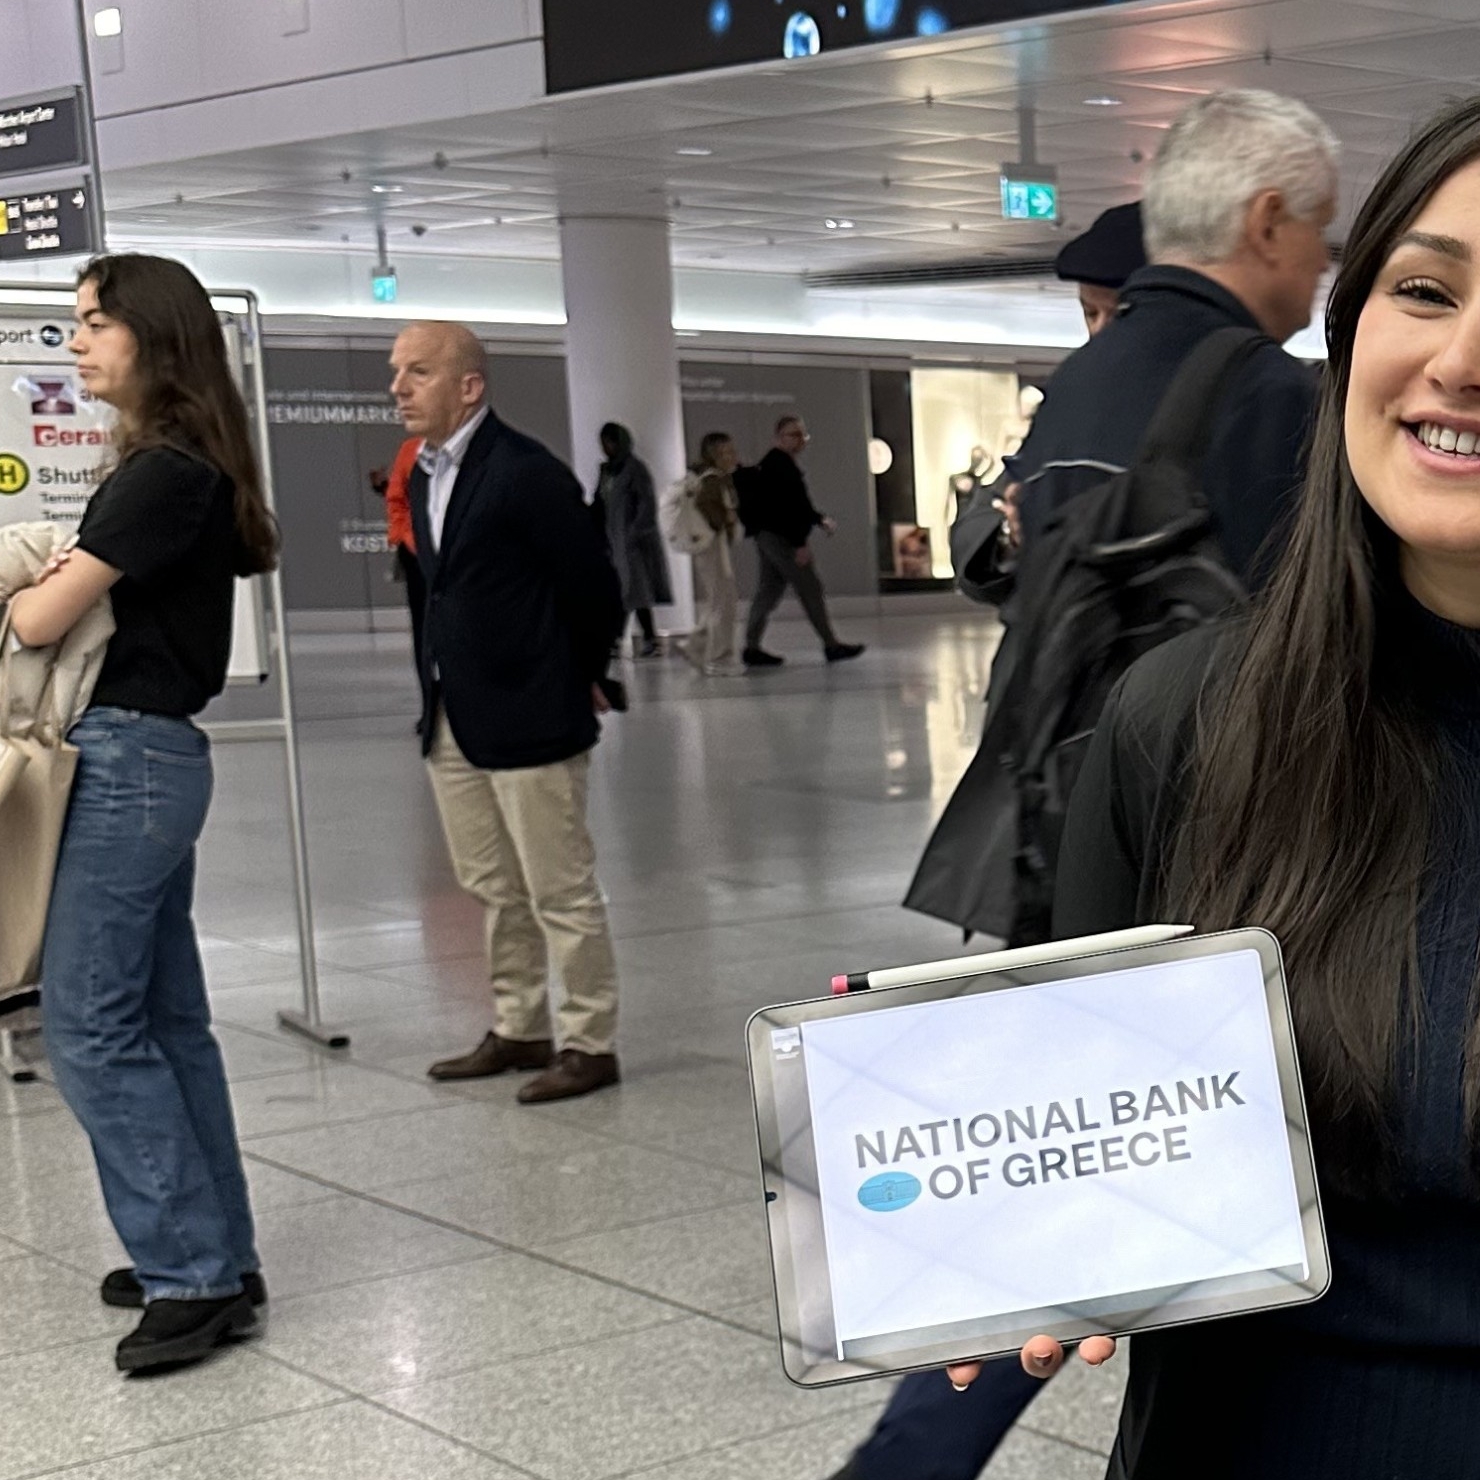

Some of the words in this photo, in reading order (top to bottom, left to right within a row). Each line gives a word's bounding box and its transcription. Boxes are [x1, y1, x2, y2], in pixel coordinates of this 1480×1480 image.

[855, 1098, 1101, 1169] NATIONAL
[1110, 1070, 1246, 1126] BANK
[928, 1158, 990, 1200] OF
[1001, 1125, 1192, 1188] GREECE
